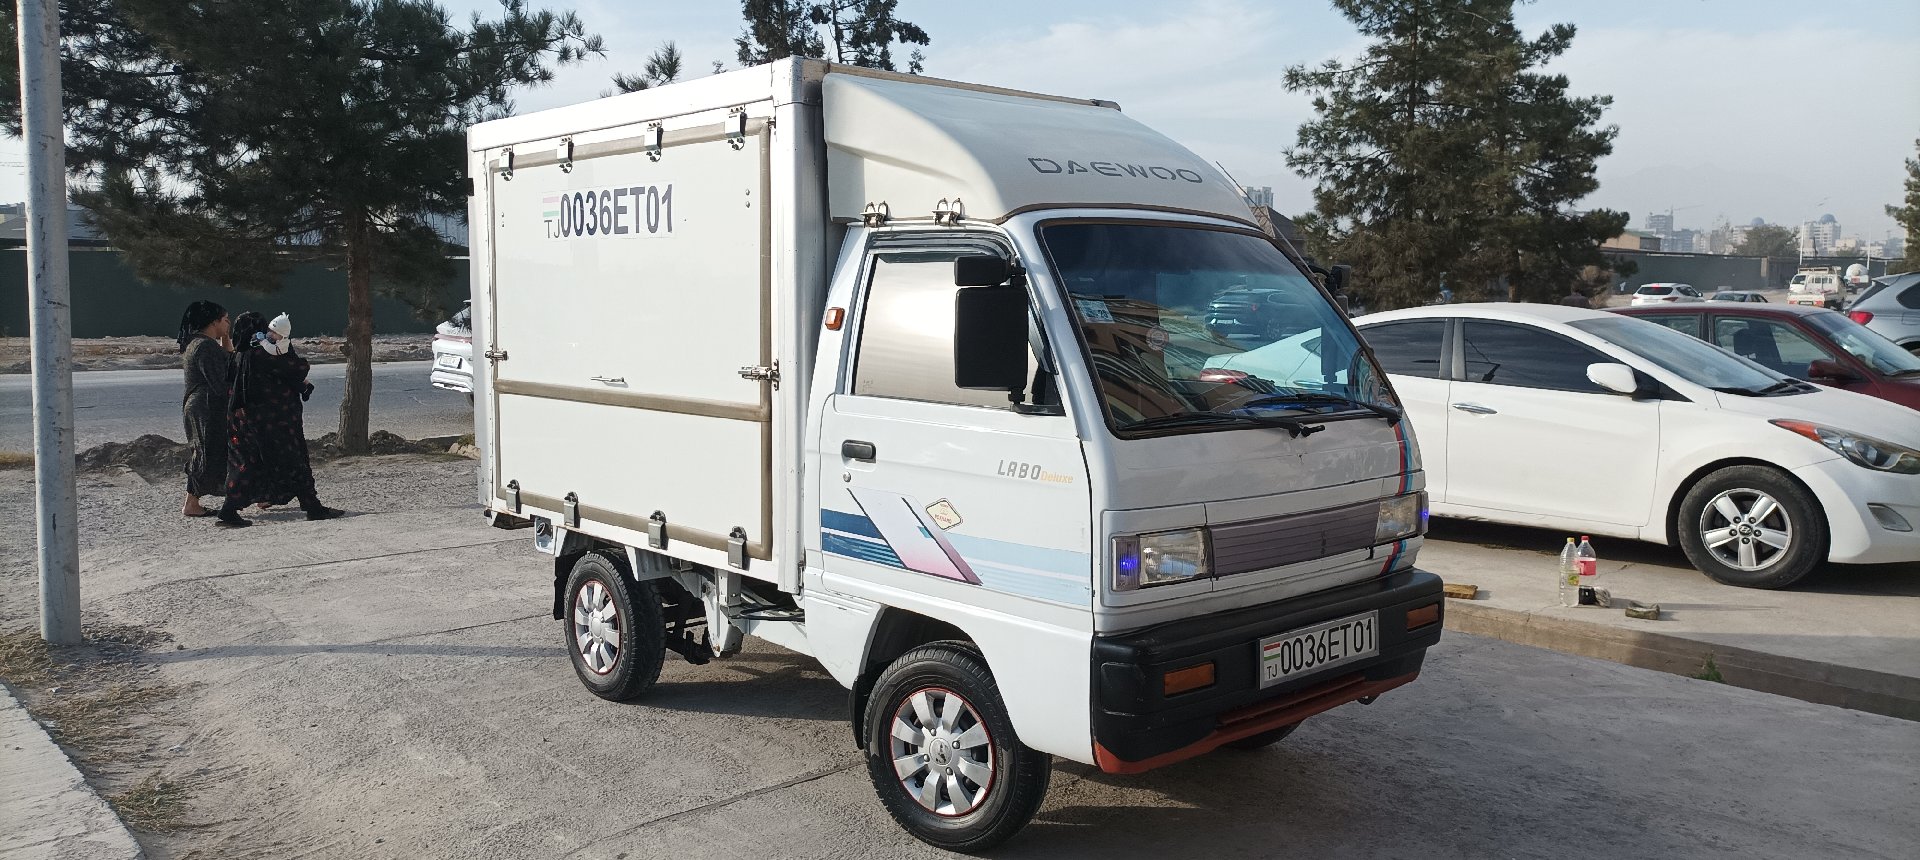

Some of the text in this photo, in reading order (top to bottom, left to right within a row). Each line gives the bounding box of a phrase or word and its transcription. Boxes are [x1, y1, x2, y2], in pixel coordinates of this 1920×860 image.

[1028, 157, 1203, 184] DAEWOO
[544, 183, 673, 239] TJ 0036ET01
[997, 459, 1074, 484] LABO Deluxe
[1266, 618, 1373, 679] TJ 0036ET01
